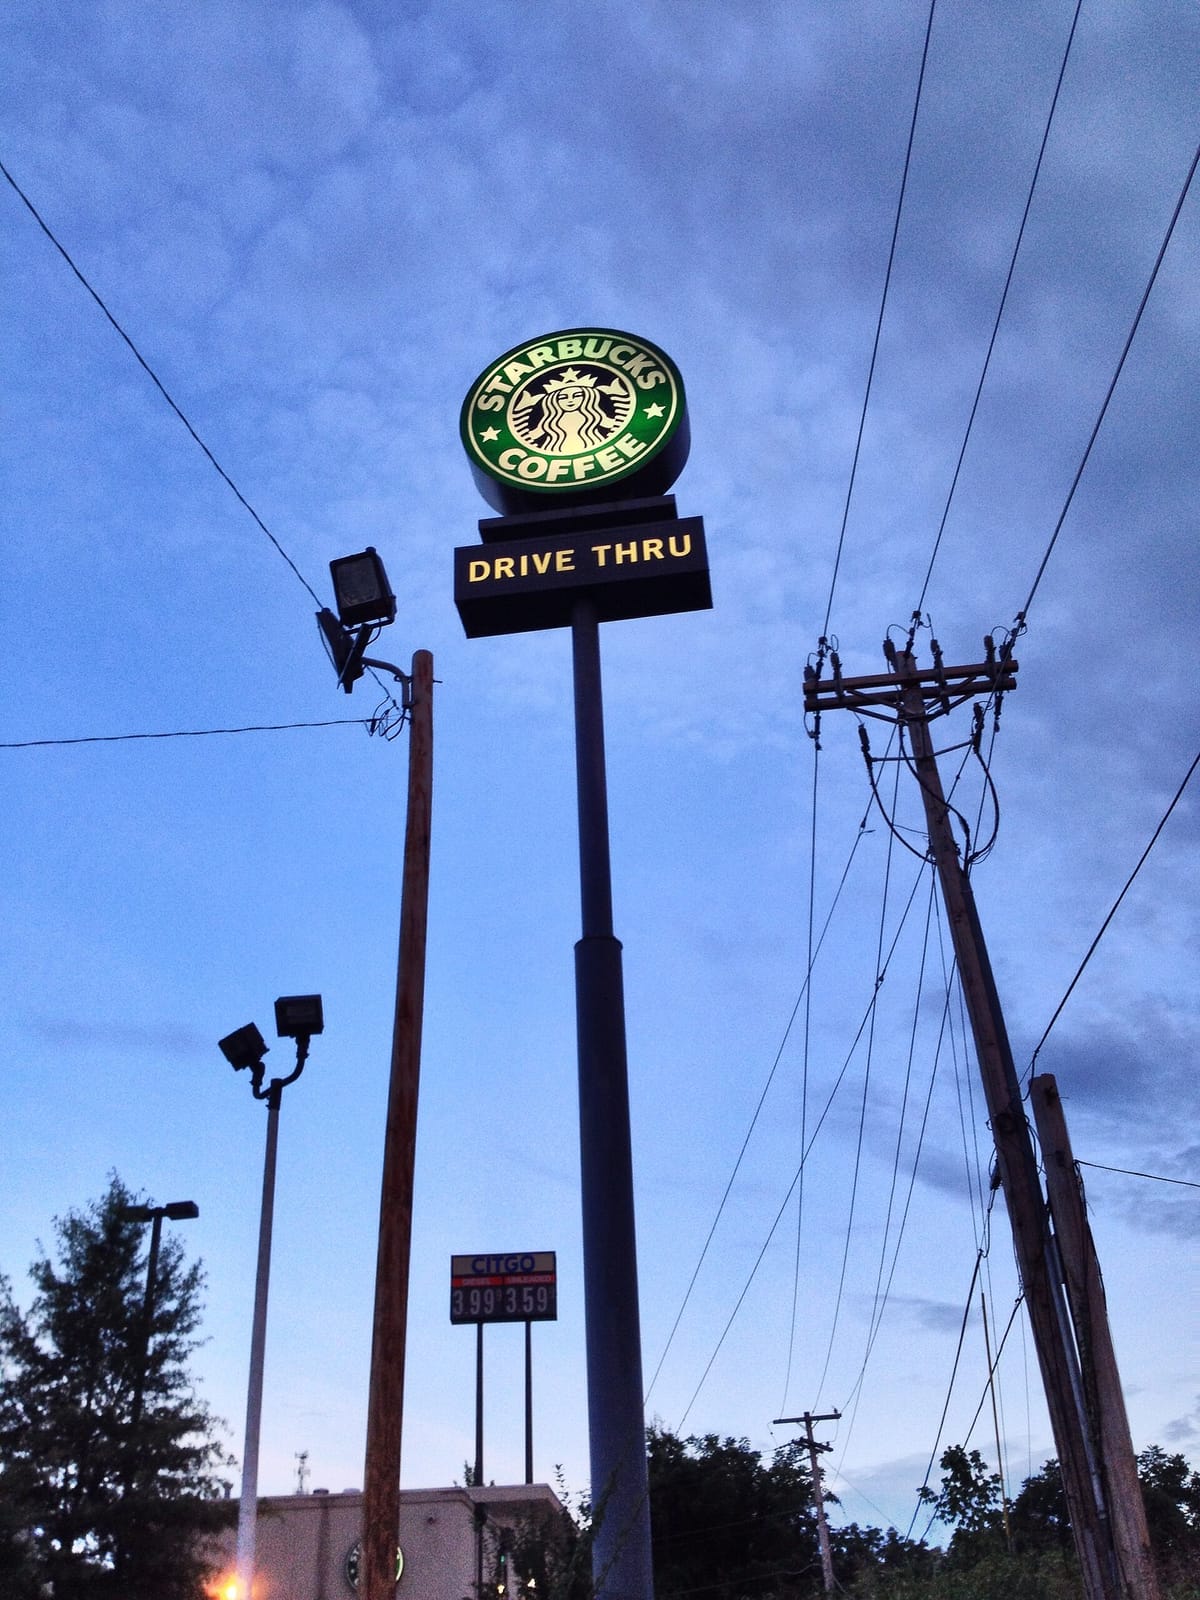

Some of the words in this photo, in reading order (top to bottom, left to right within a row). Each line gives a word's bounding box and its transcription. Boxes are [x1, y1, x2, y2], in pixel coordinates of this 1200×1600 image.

[477, 338, 666, 413] STARBUCKS
[498, 433, 647, 482] COFFEE
[468, 549, 576, 583] DRIVE
[591, 534, 692, 567] THRU
[471, 1255, 536, 1273] CITGO
